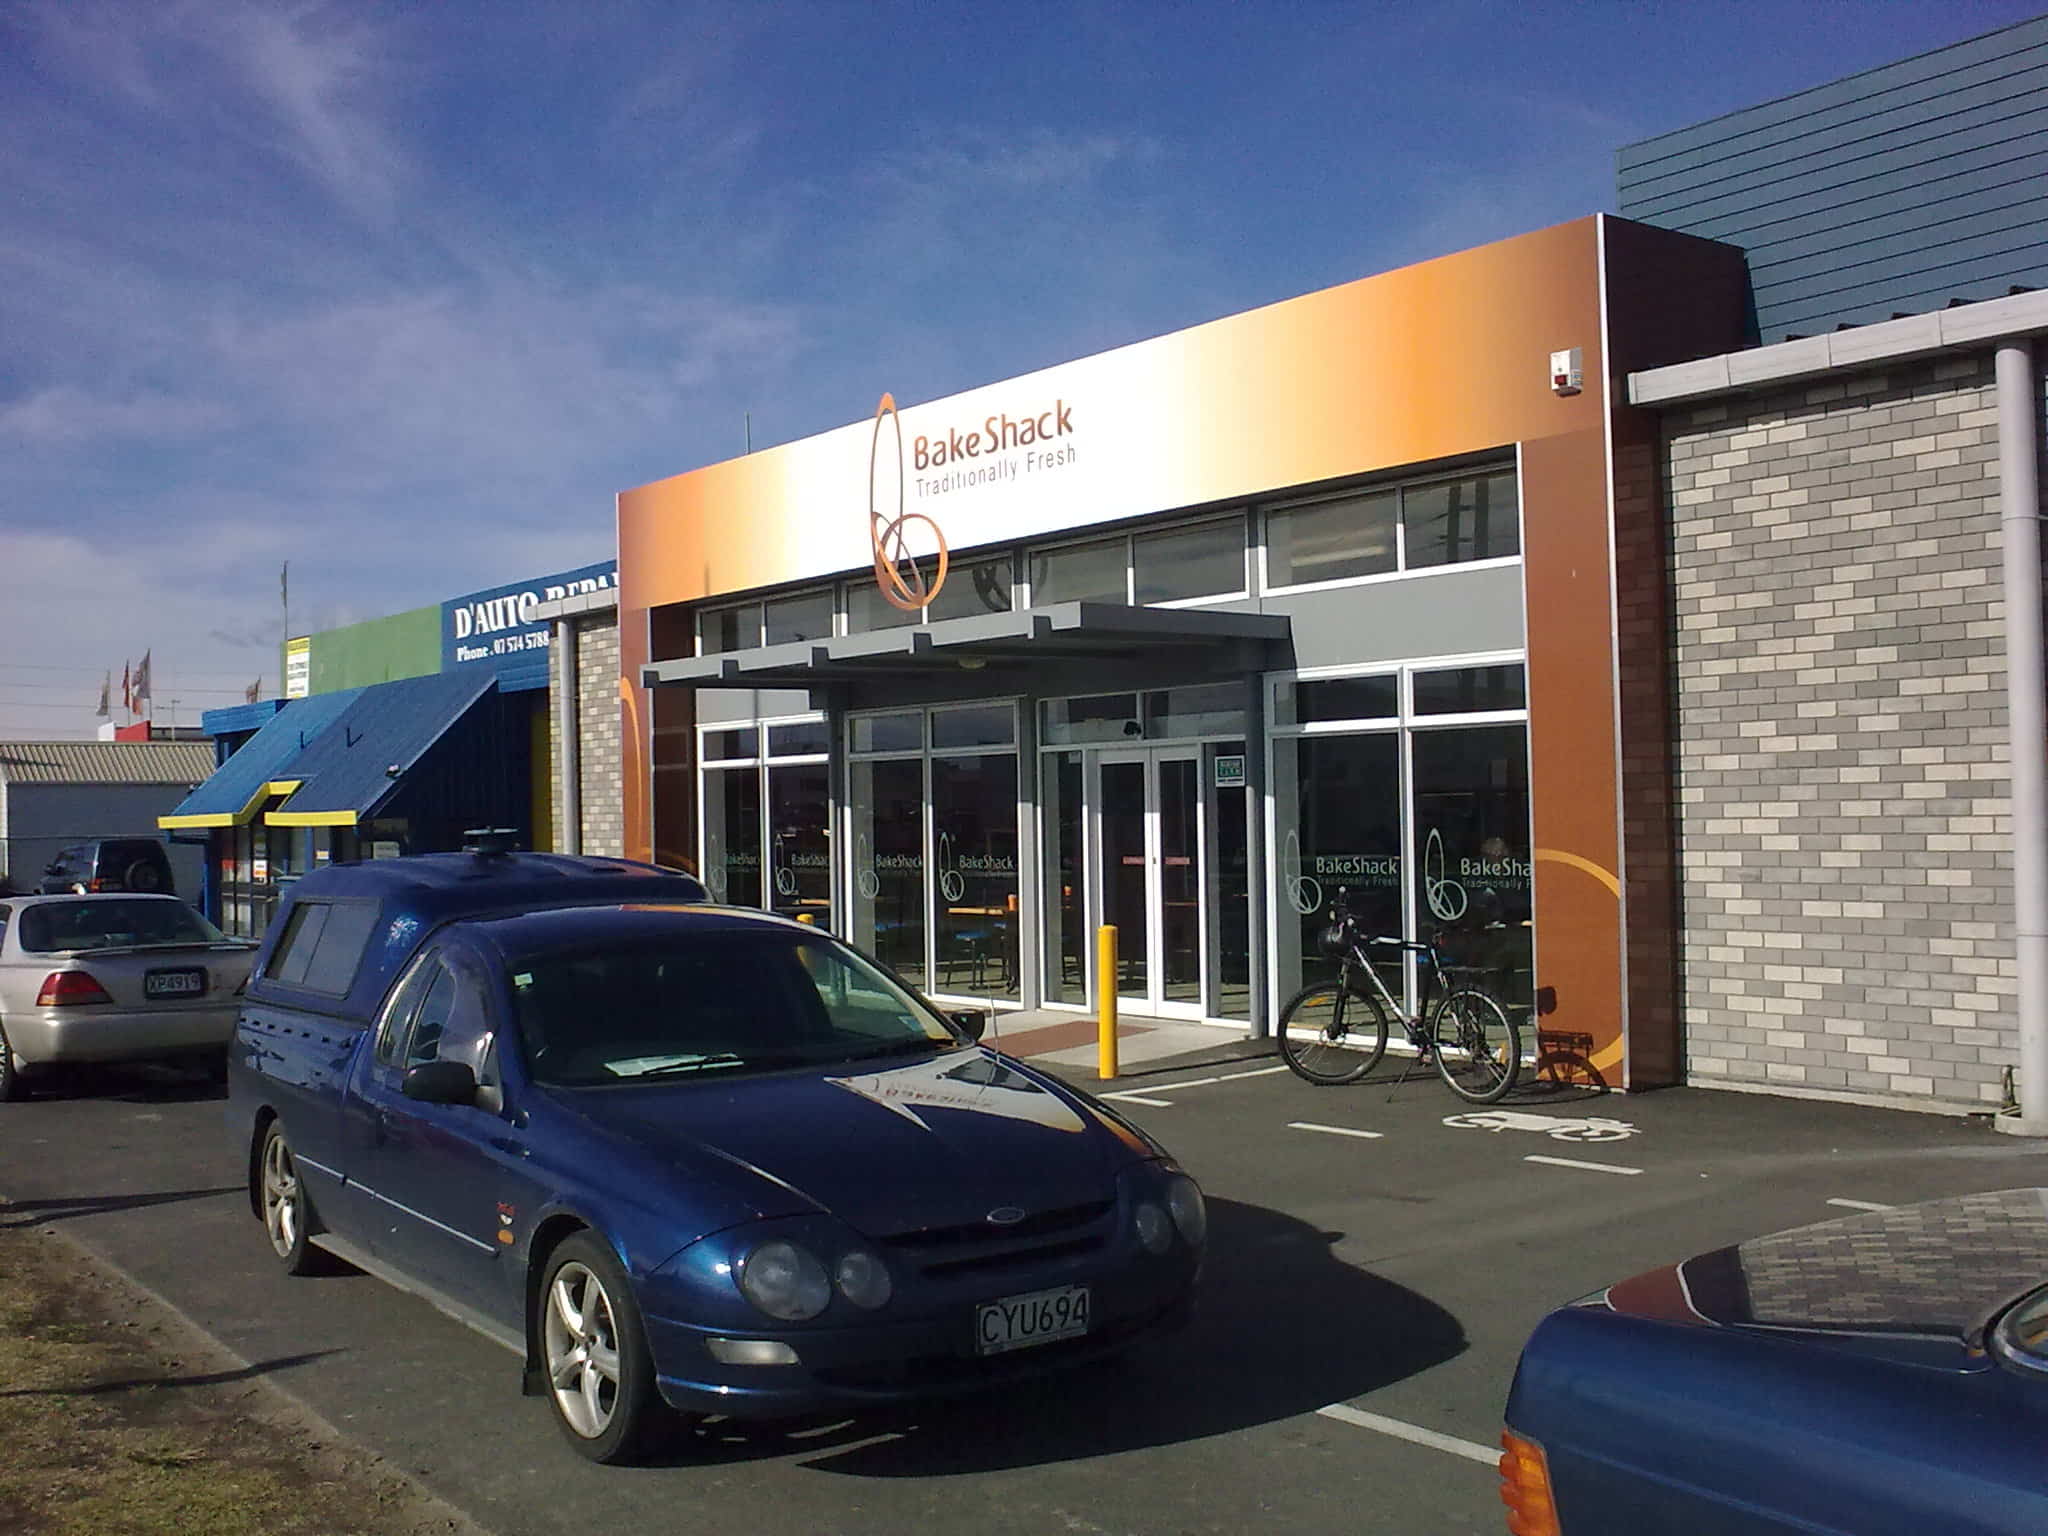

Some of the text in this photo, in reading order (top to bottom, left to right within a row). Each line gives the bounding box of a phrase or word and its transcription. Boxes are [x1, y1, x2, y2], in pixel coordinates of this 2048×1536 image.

[914, 399, 1074, 471] BakeShack
[916, 443, 1076, 498] Traditionally Fresh
[1316, 856, 1397, 874] BakeShack
[1461, 857, 1532, 877] BakeSha
[982, 1291, 1088, 1343] CYU694
